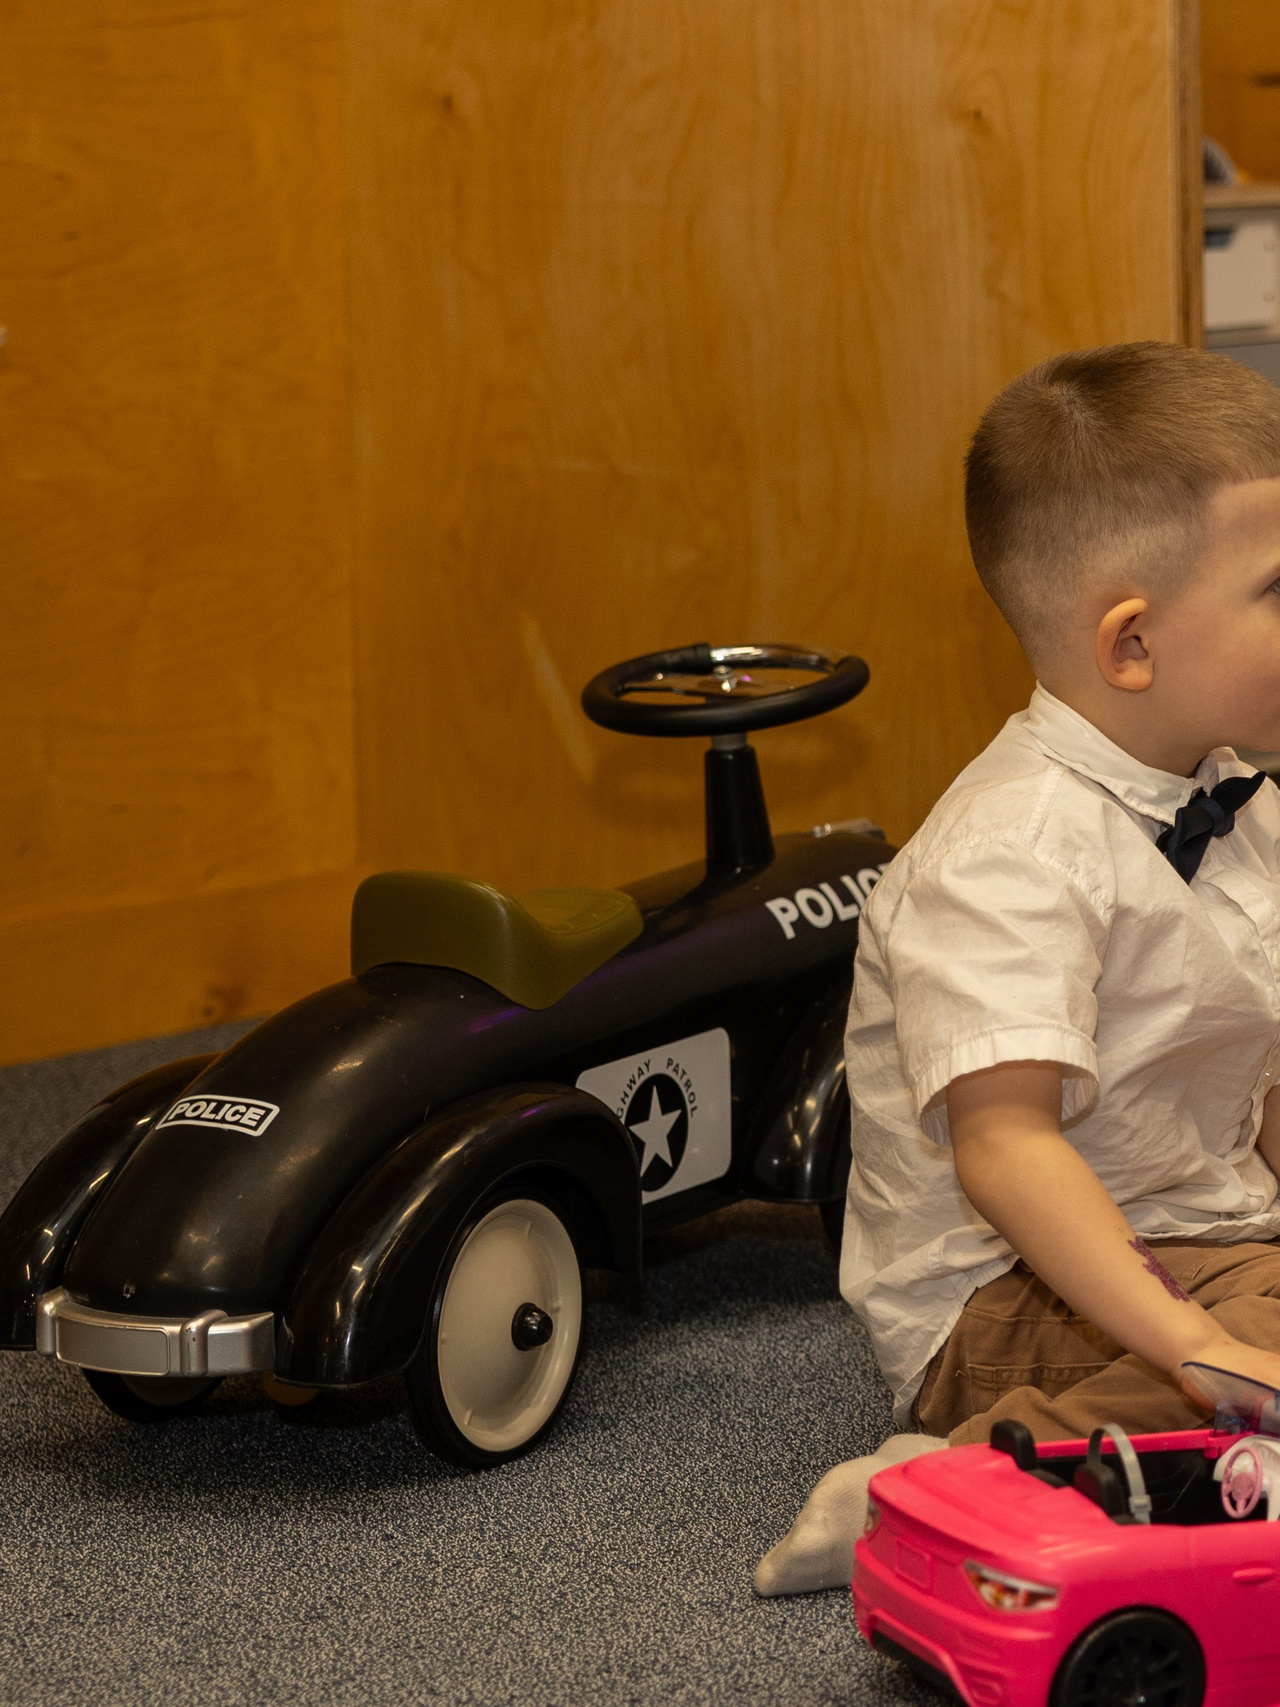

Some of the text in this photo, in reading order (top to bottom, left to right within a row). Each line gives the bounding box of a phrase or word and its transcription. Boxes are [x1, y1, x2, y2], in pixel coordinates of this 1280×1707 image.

[764, 862, 891, 940] POLIC
[167, 1100, 266, 1127] POLICE
[616, 1057, 699, 1120] GHWAY PATROL
